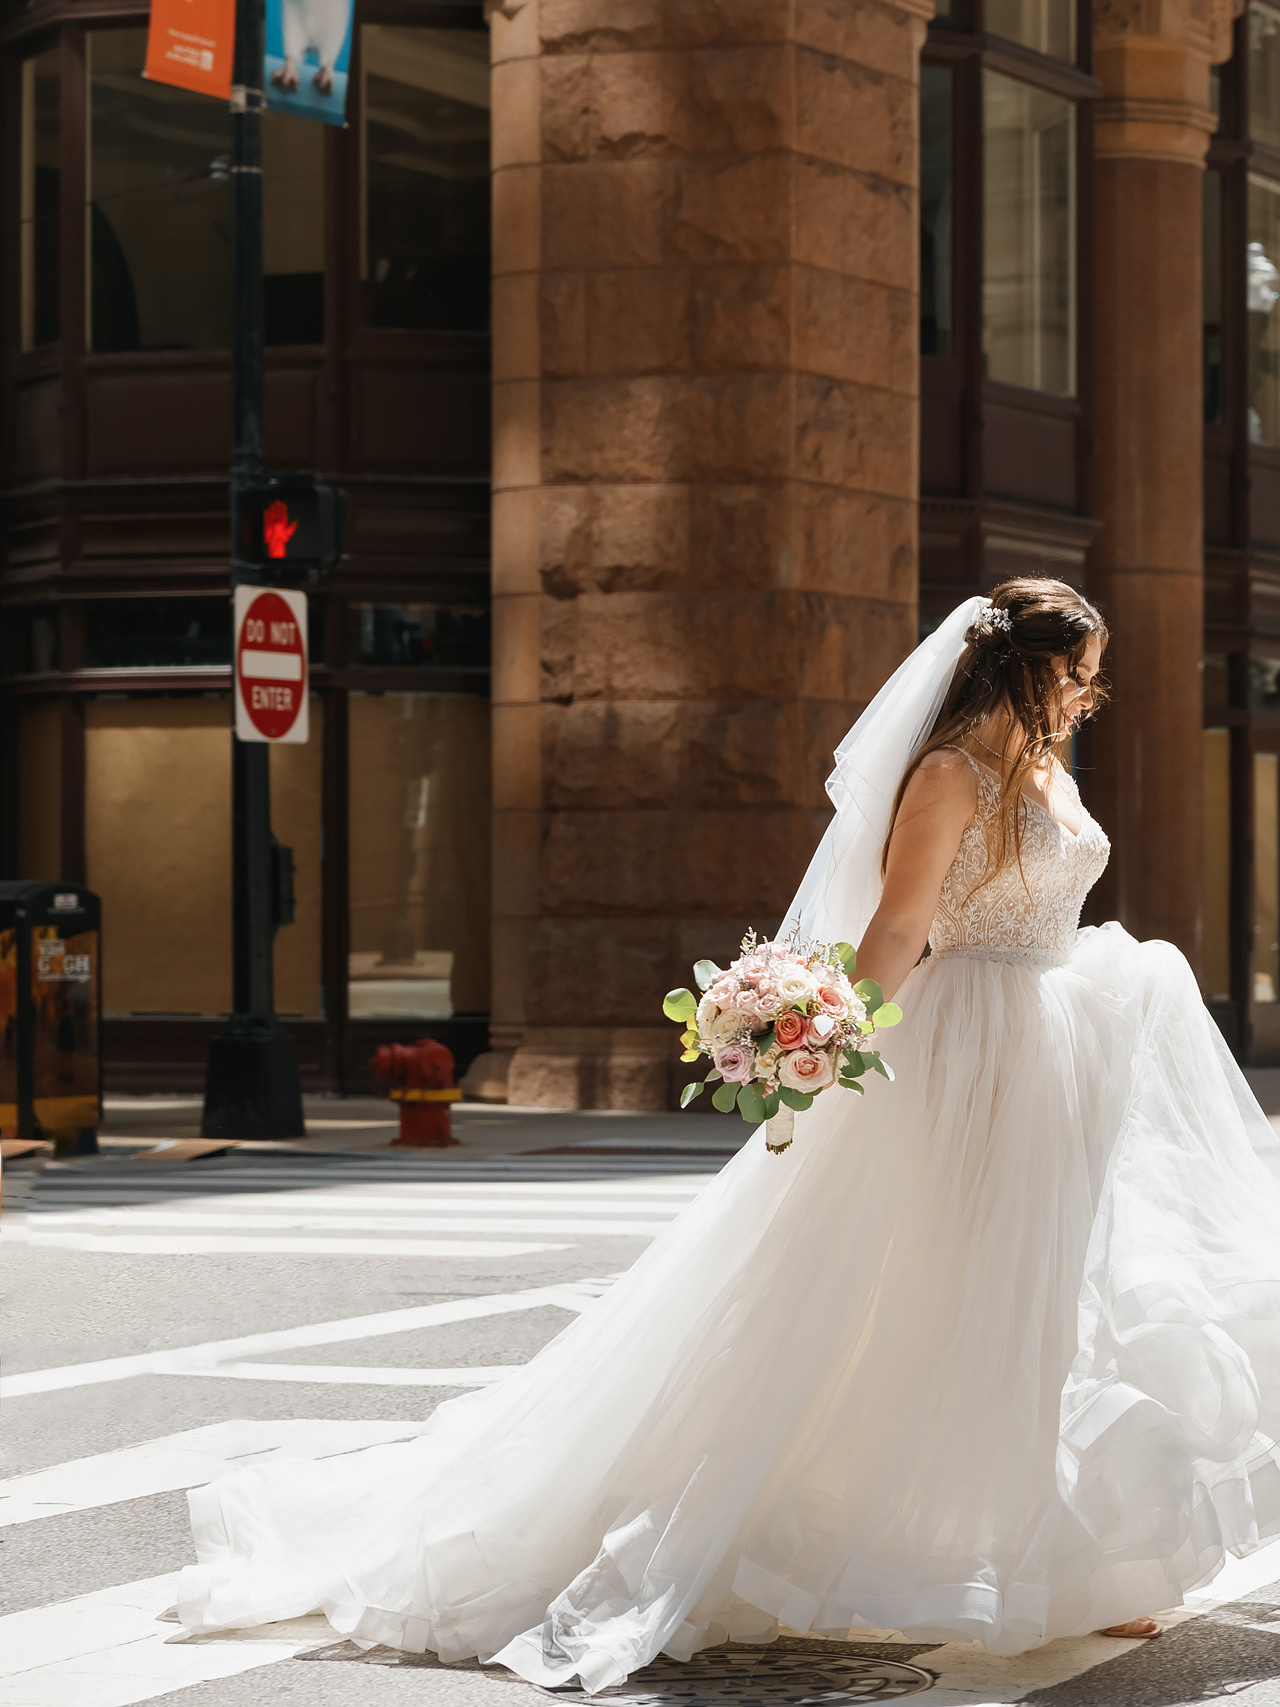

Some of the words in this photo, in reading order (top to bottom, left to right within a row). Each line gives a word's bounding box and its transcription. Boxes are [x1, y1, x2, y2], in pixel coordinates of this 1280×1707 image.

[246, 618, 264, 643] DO
[270, 621, 296, 645] NOT
[252, 685, 293, 711] ENTER
